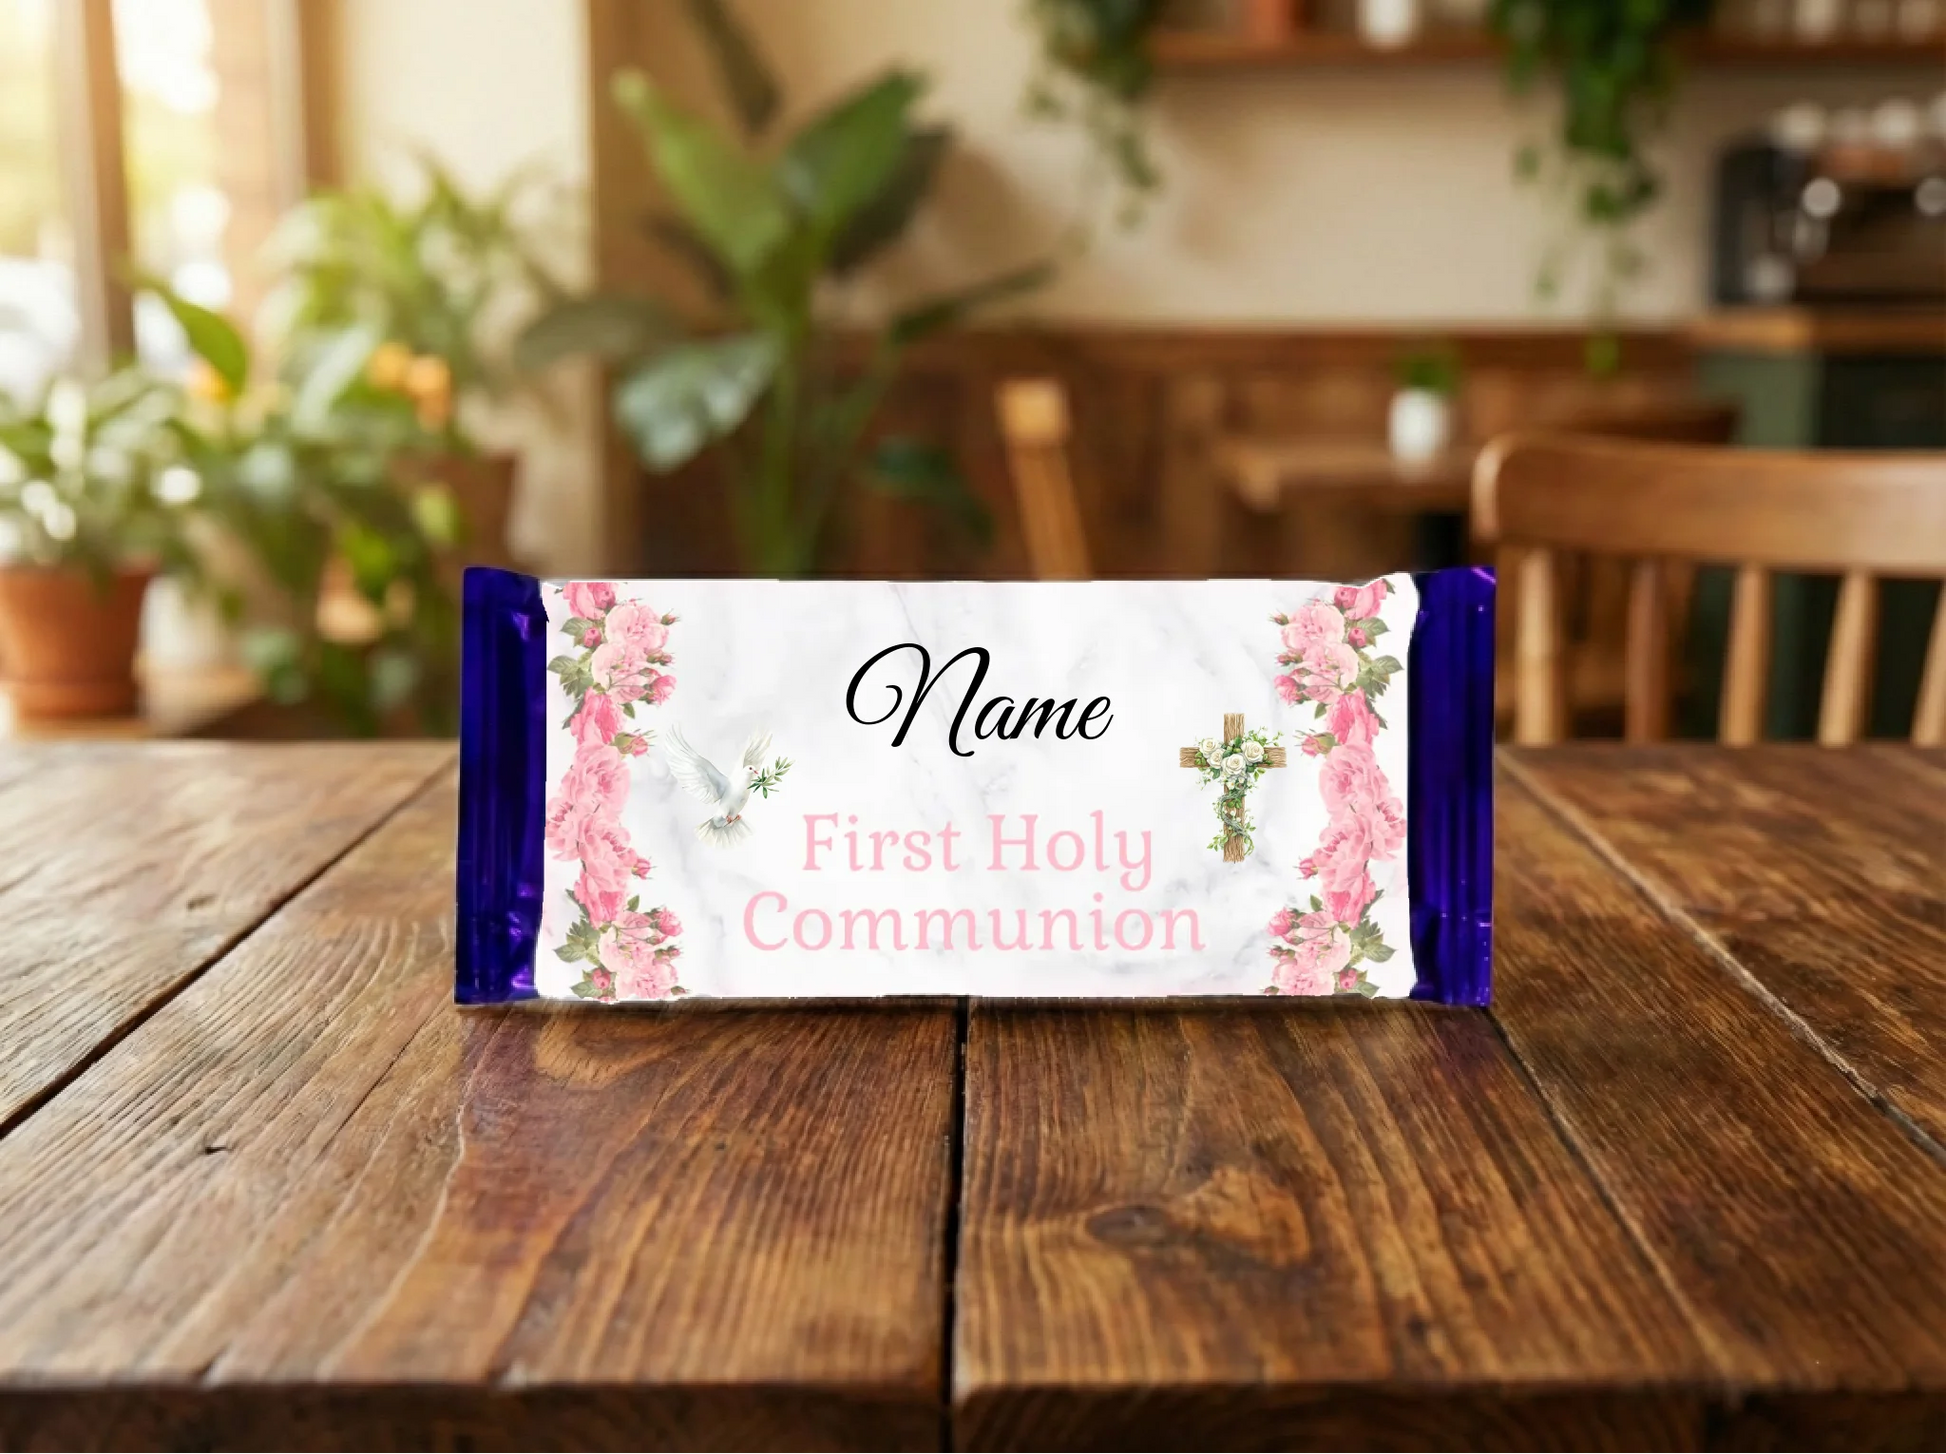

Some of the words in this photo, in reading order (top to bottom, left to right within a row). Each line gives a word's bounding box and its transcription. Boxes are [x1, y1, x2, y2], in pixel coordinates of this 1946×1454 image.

[844, 641, 1115, 758] Name
[802, 813, 962, 873] First
[986, 809, 1155, 893] Holy
[742, 889, 1206, 953] Communion
